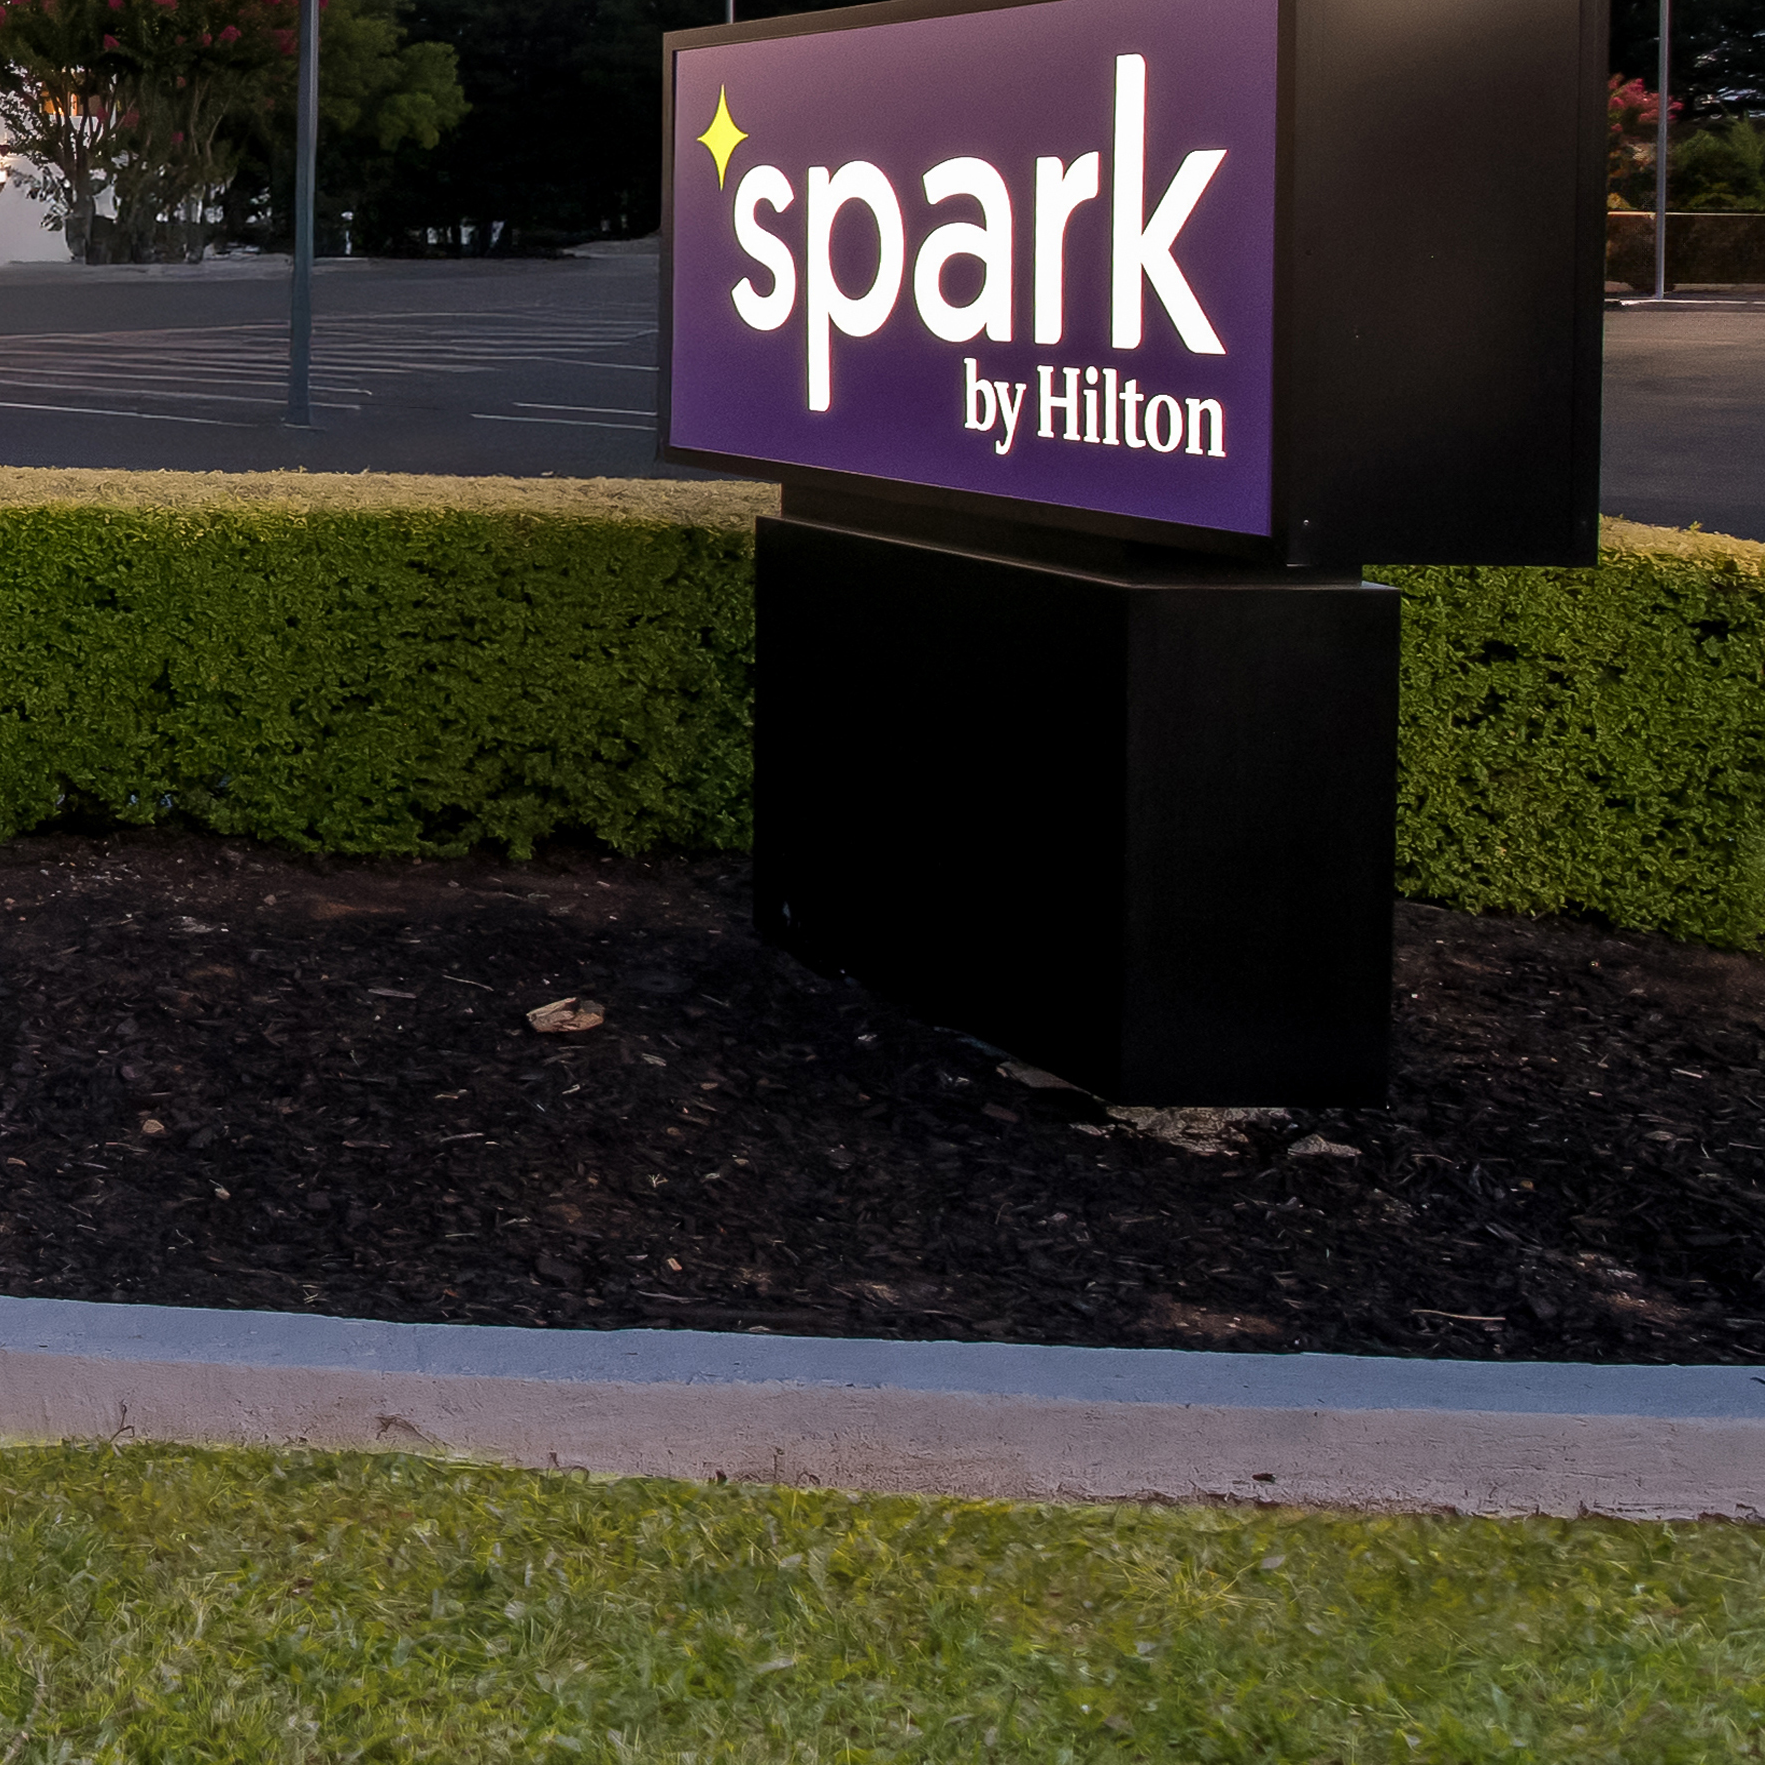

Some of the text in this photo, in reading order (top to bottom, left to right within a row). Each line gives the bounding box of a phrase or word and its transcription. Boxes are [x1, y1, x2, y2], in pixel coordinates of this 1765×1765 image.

[731, 53, 1228, 412] spark
[964, 357, 1227, 458] by Hilton
